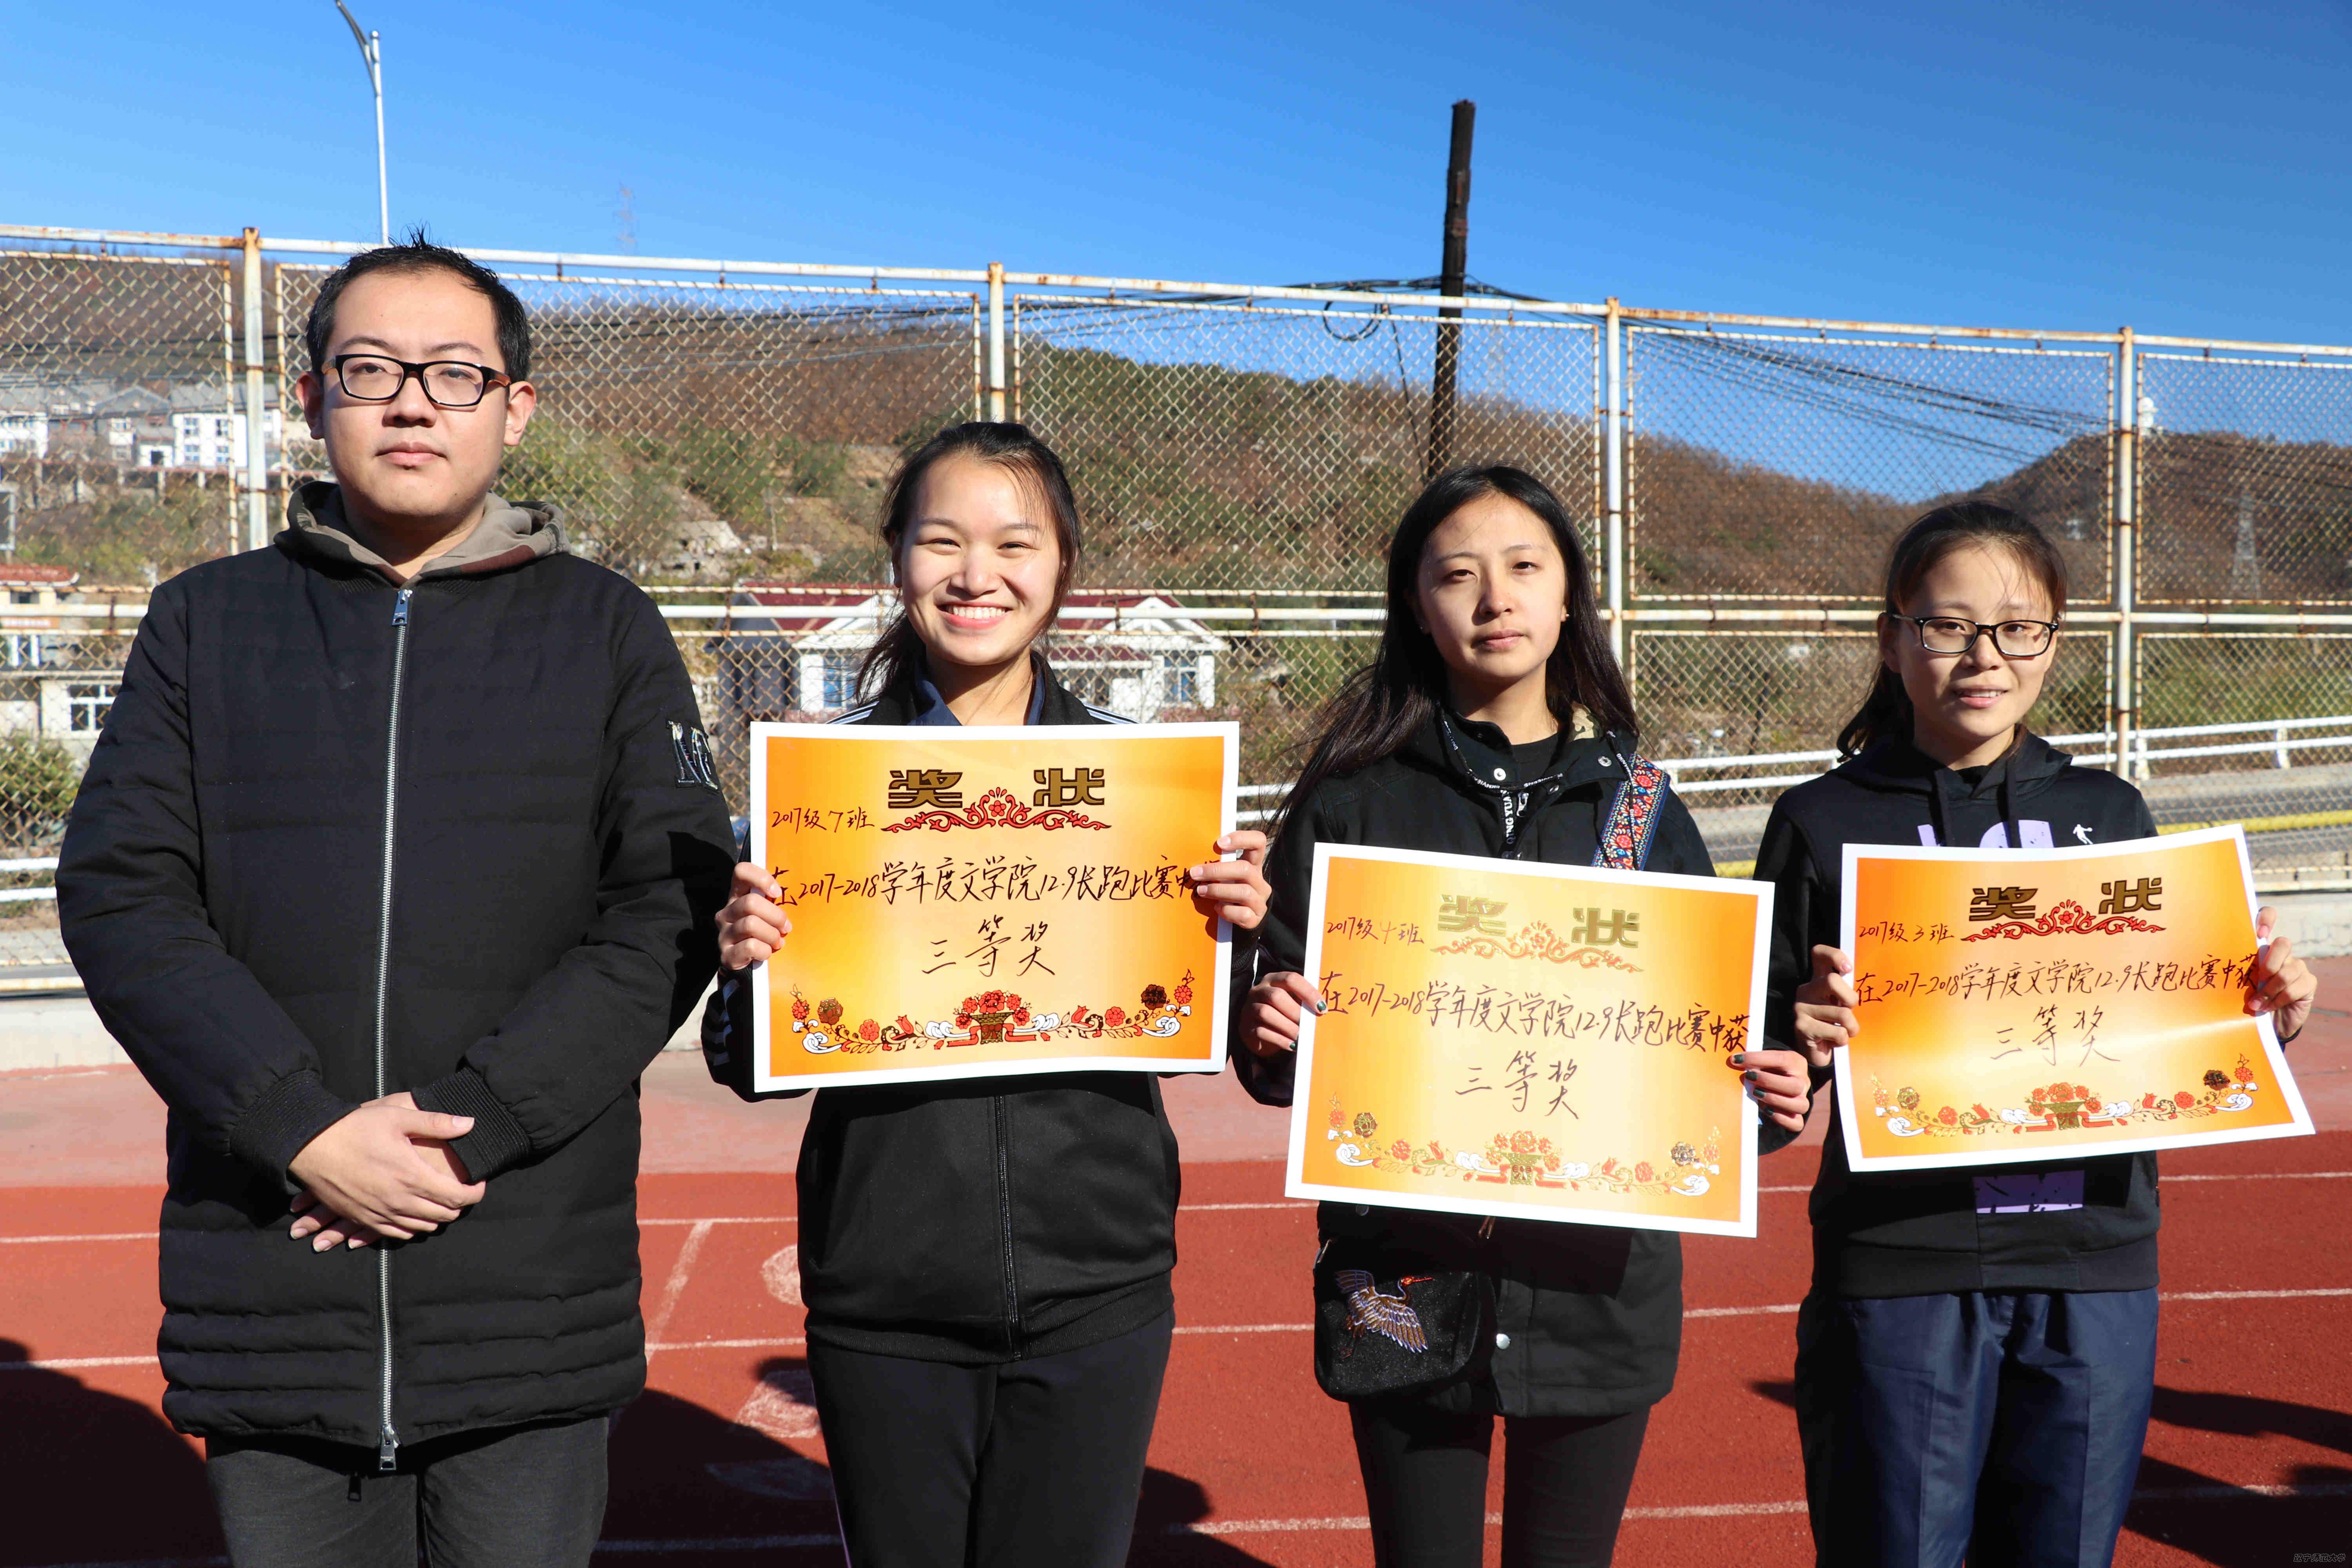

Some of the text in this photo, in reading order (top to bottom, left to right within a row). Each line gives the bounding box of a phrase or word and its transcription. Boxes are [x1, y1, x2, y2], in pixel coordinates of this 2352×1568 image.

[888, 768, 1105, 809] 奖状
[771, 806, 875, 834] 2017级7班
[1437, 894, 1641, 949] 奖状
[1968, 877, 2163, 922] 奖状
[922, 914, 1055, 978] 三等奖
[1327, 917, 1425, 946] 2017级4班
[1859, 921, 1955, 944] 2017级3班
[1990, 1005, 2121, 1067] 三等奖
[1455, 1050, 1579, 1120] 三等奖
